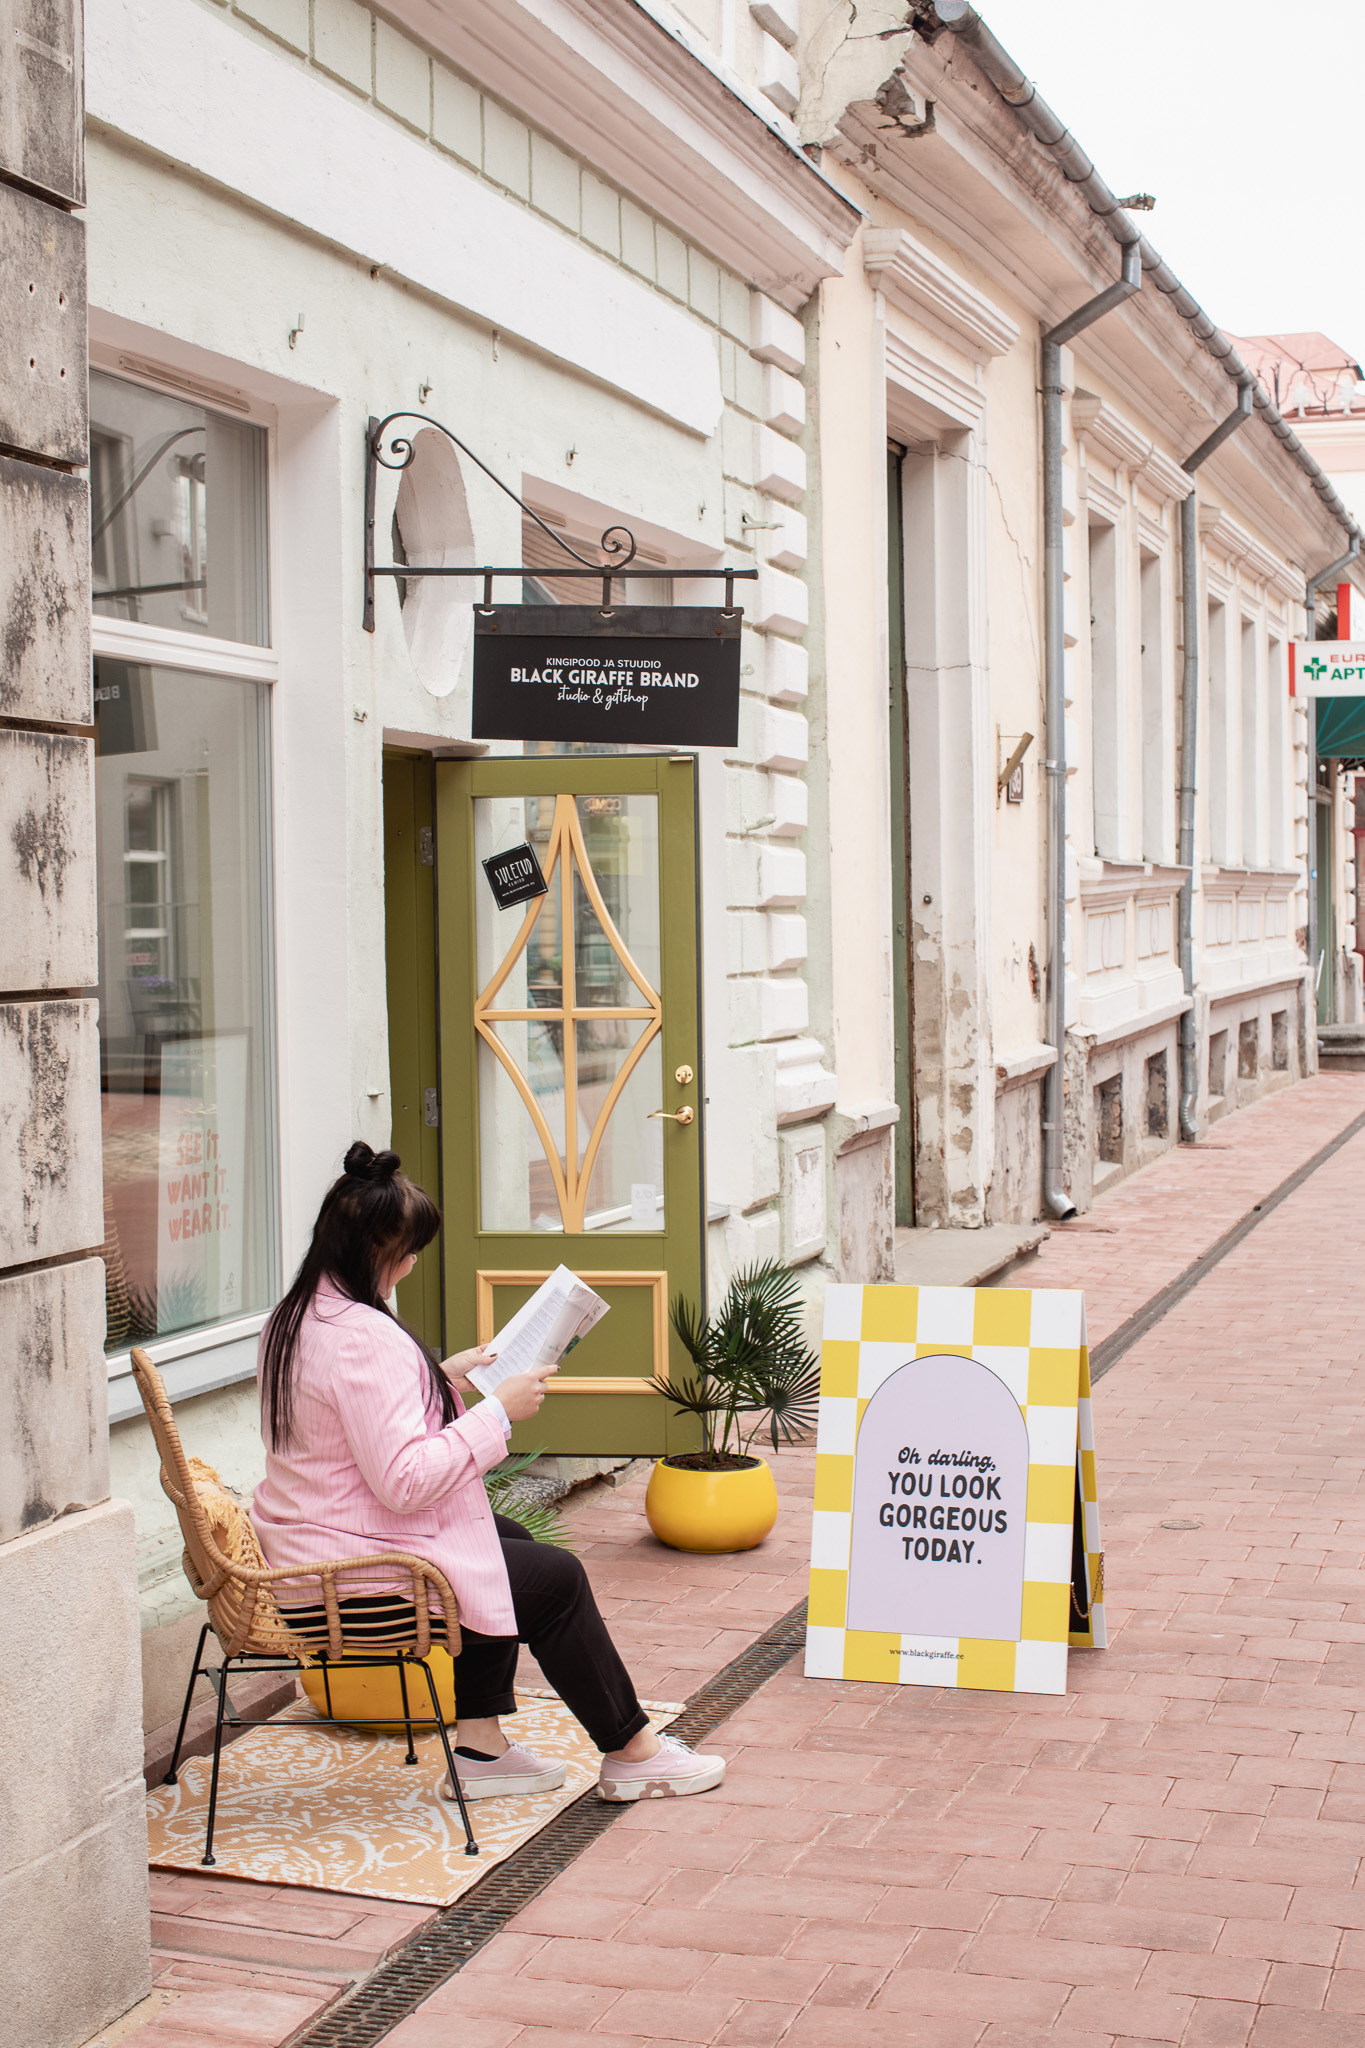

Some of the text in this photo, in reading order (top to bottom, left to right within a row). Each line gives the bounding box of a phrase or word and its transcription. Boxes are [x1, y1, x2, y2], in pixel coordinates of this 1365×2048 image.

[546, 657, 662, 669] KINGIPOOD JA STUUDIO
[1331, 668, 1365, 680] APT
[511, 667, 699, 688] BLACK GIRAFFE BRAND
[557, 684, 649, 711] studio & giftshop
[494, 858, 533, 886] SULETUD
[176, 1132, 202, 1166] SEE
[168, 1172, 210, 1205] WANT
[169, 1202, 212, 1242] WEAR
[898, 1446, 996, 1473] Oh darling,
[888, 1471, 1002, 1500] YOU LOOK
[879, 1503, 1008, 1533] GORGEOUS
[902, 1537, 982, 1565] TODAY.
[889, 1648, 965, 1660] www.blackgiraffe.ee
